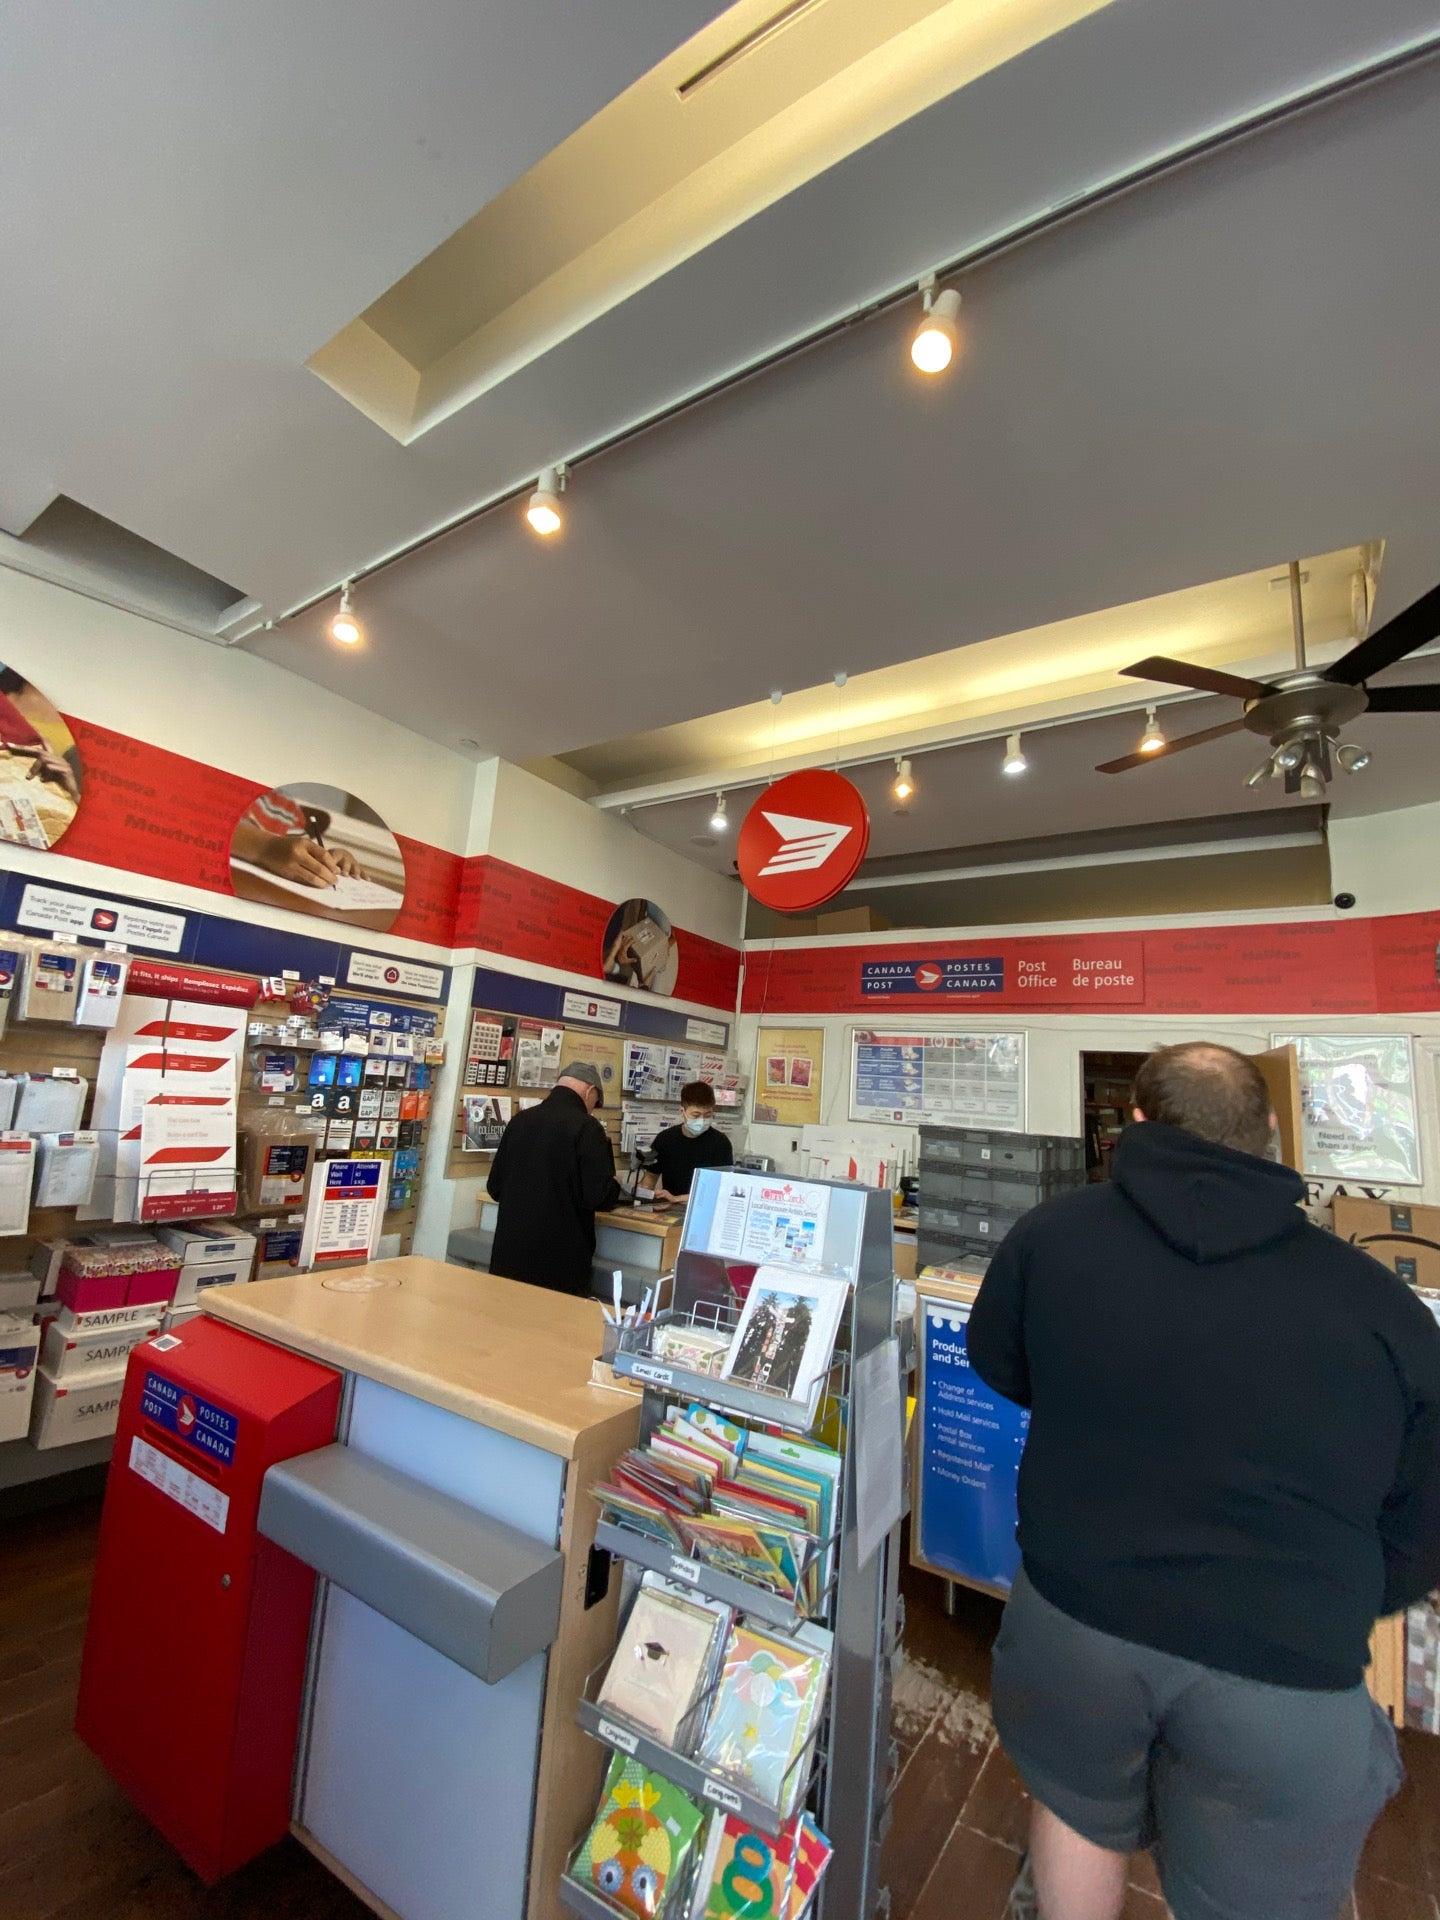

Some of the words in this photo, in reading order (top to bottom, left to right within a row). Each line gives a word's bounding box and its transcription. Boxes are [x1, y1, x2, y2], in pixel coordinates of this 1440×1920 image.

[867, 966, 912, 975] CANADA
[946, 962, 990, 972] POSTES
[1018, 960, 1046, 972] Post
[1073, 958, 1122, 971] Bureau
[160, 974, 179, 983] ships
[867, 980, 893, 990] POST
[946, 978, 996, 988] CANADA
[1018, 975, 1057, 988] Office
[1073, 974, 1090, 986] de
[1094, 974, 1134, 989] poste
[1318, 1131, 1344, 1141] Need
[1347, 1134, 1374, 1142] me
[1316, 1140, 1340, 1150] than
[84, 1310, 138, 1328] SAMPLE
[932, 1338, 967, 1356] Produc
[932, 1352, 952, 1364] and
[148, 1377, 178, 1401] CANADA
[938, 1380, 964, 1396] Change
[966, 1388, 974, 1396] of
[938, 1391, 966, 1404] Address
[966, 1398, 994, 1411] services
[144, 1399, 162, 1417] POST
[200, 1406, 230, 1431] POSTES
[938, 1406, 954, 1418] Hold
[956, 1411, 971, 1422] Mail
[972, 1416, 1000, 1430] services
[958, 1429, 972, 1440] Box
[196, 1430, 230, 1458] CANADA
[958, 1440, 986, 1454] services
[938, 1466, 960, 1483] Money
[962, 1476, 986, 1490] Orders
